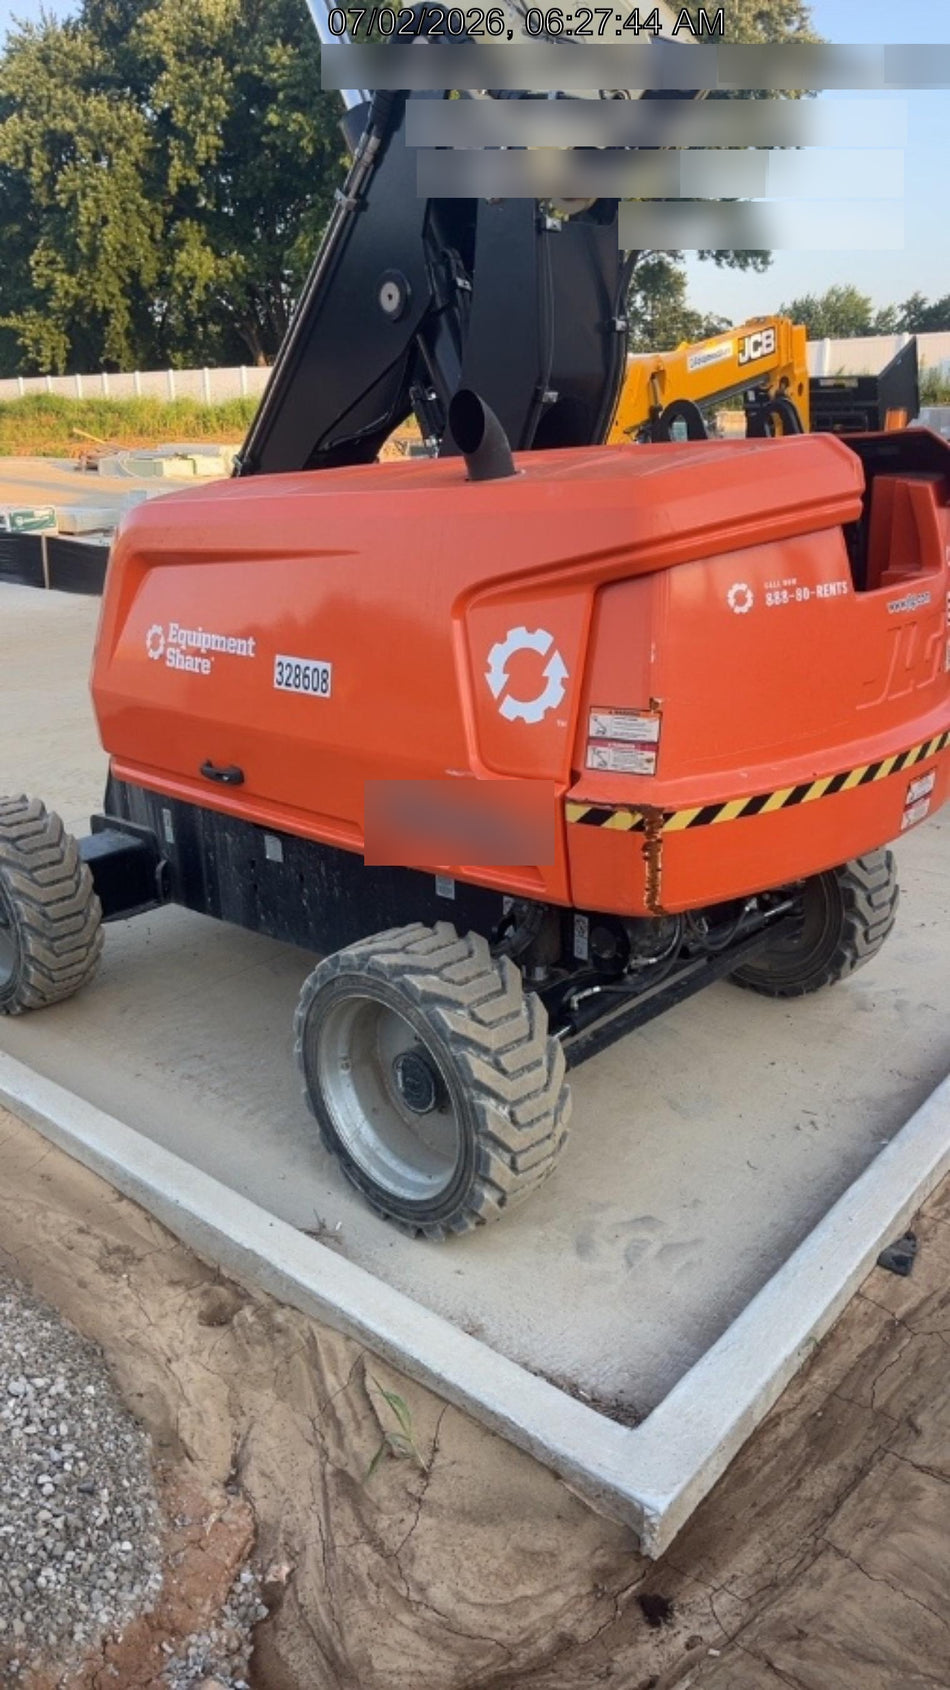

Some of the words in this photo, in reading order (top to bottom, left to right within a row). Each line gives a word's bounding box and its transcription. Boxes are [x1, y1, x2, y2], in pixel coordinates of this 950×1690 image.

[738, 328, 775, 364] JCB
[765, 581, 848, 607] 888-80-RENTS
[168, 622, 256, 657] Equipment
[165, 646, 212, 675] Share
[275, 661, 330, 694] 328608
